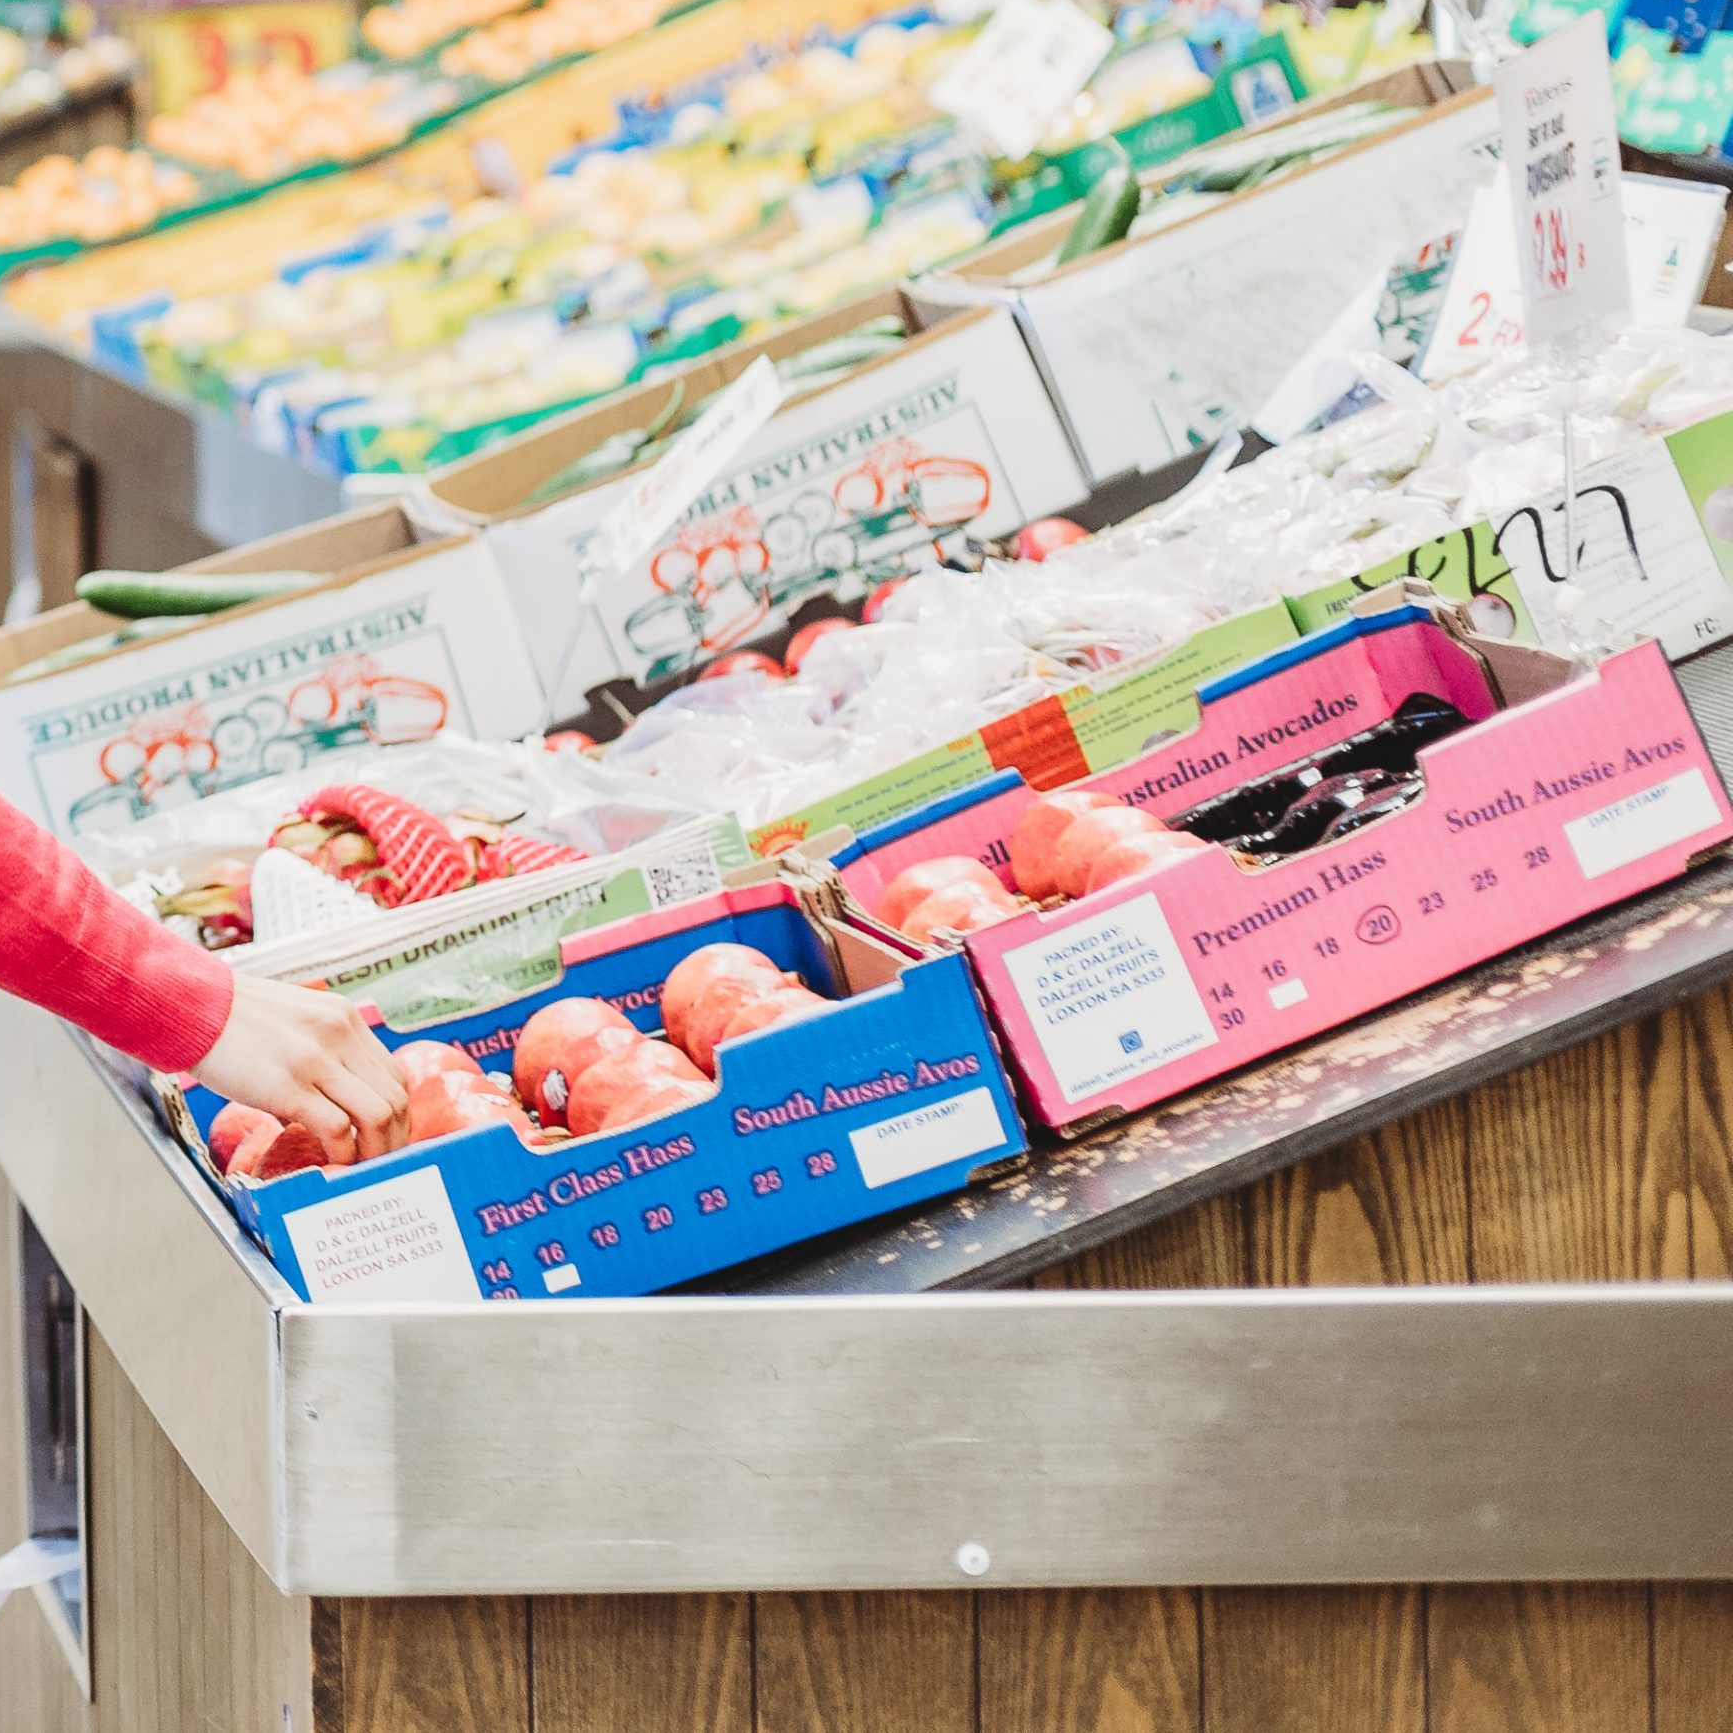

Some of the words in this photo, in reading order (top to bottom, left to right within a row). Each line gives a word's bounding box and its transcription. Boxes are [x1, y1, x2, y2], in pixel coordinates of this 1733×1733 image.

[750, 379, 960, 491] AUSTRALIAN
[205, 603, 429, 689] AUSTRALIAN
[31, 680, 197, 746] PRODUCE
[1118, 752, 1233, 808] ustralian
[1235, 691, 1359, 769] Avocados
[1445, 789, 1529, 834] South
[1534, 760, 1616, 804] Aussie
[1623, 736, 1687, 772] Avos
[1588, 806, 1622, 828] DATE
[1191, 886, 1319, 957] Premium
[1317, 850, 1388, 893] Hass
[1209, 982, 1235, 1003] 14
[1261, 959, 1287, 981] 16
[1314, 936, 1340, 959] 18
[1366, 914, 1393, 938] 20
[1418, 892, 1445, 916] 23
[1471, 868, 1498, 892] 25
[1524, 846, 1551, 869] 28
[1037, 976, 1050, 989] D
[1052, 969, 1064, 982] &
[1066, 964, 1078, 977] C
[1081, 936, 1146, 971] DALZELL
[1038, 974, 1103, 1009] DALZELL
[1106, 950, 1160, 980] FRUITS
[1044, 936, 1099, 966] PACKED
[1046, 992, 1108, 1025] LOXTON
[1110, 982, 1132, 998] SA
[1133, 966, 1166, 990] 5333
[1219, 1007, 1245, 1030] 30
[733, 1089, 819, 1135] South
[820, 1069, 911, 1114] Aussie
[913, 1052, 981, 1090] Avos
[878, 1119, 913, 1139] DATE
[477, 1189, 549, 1235] First
[547, 1168, 626, 1207] Class
[620, 1133, 696, 1177] Hass
[315, 1240, 328, 1253] D
[331, 1234, 344, 1247] &
[346, 1229, 357, 1242] C
[359, 1208, 427, 1238] DALZELL
[325, 1204, 381, 1230] PACKED
[482, 1258, 513, 1284] 14
[536, 1241, 566, 1266] 16
[589, 1222, 621, 1250] 18
[643, 1204, 674, 1233] 20
[698, 1186, 729, 1216] 23
[752, 1168, 783, 1196] 25
[806, 1150, 837, 1179] 28
[315, 1242, 384, 1273] DALZELL
[385, 1222, 439, 1250] FRUITS
[321, 1259, 384, 1290] LOXTON
[388, 1252, 409, 1268] SA
